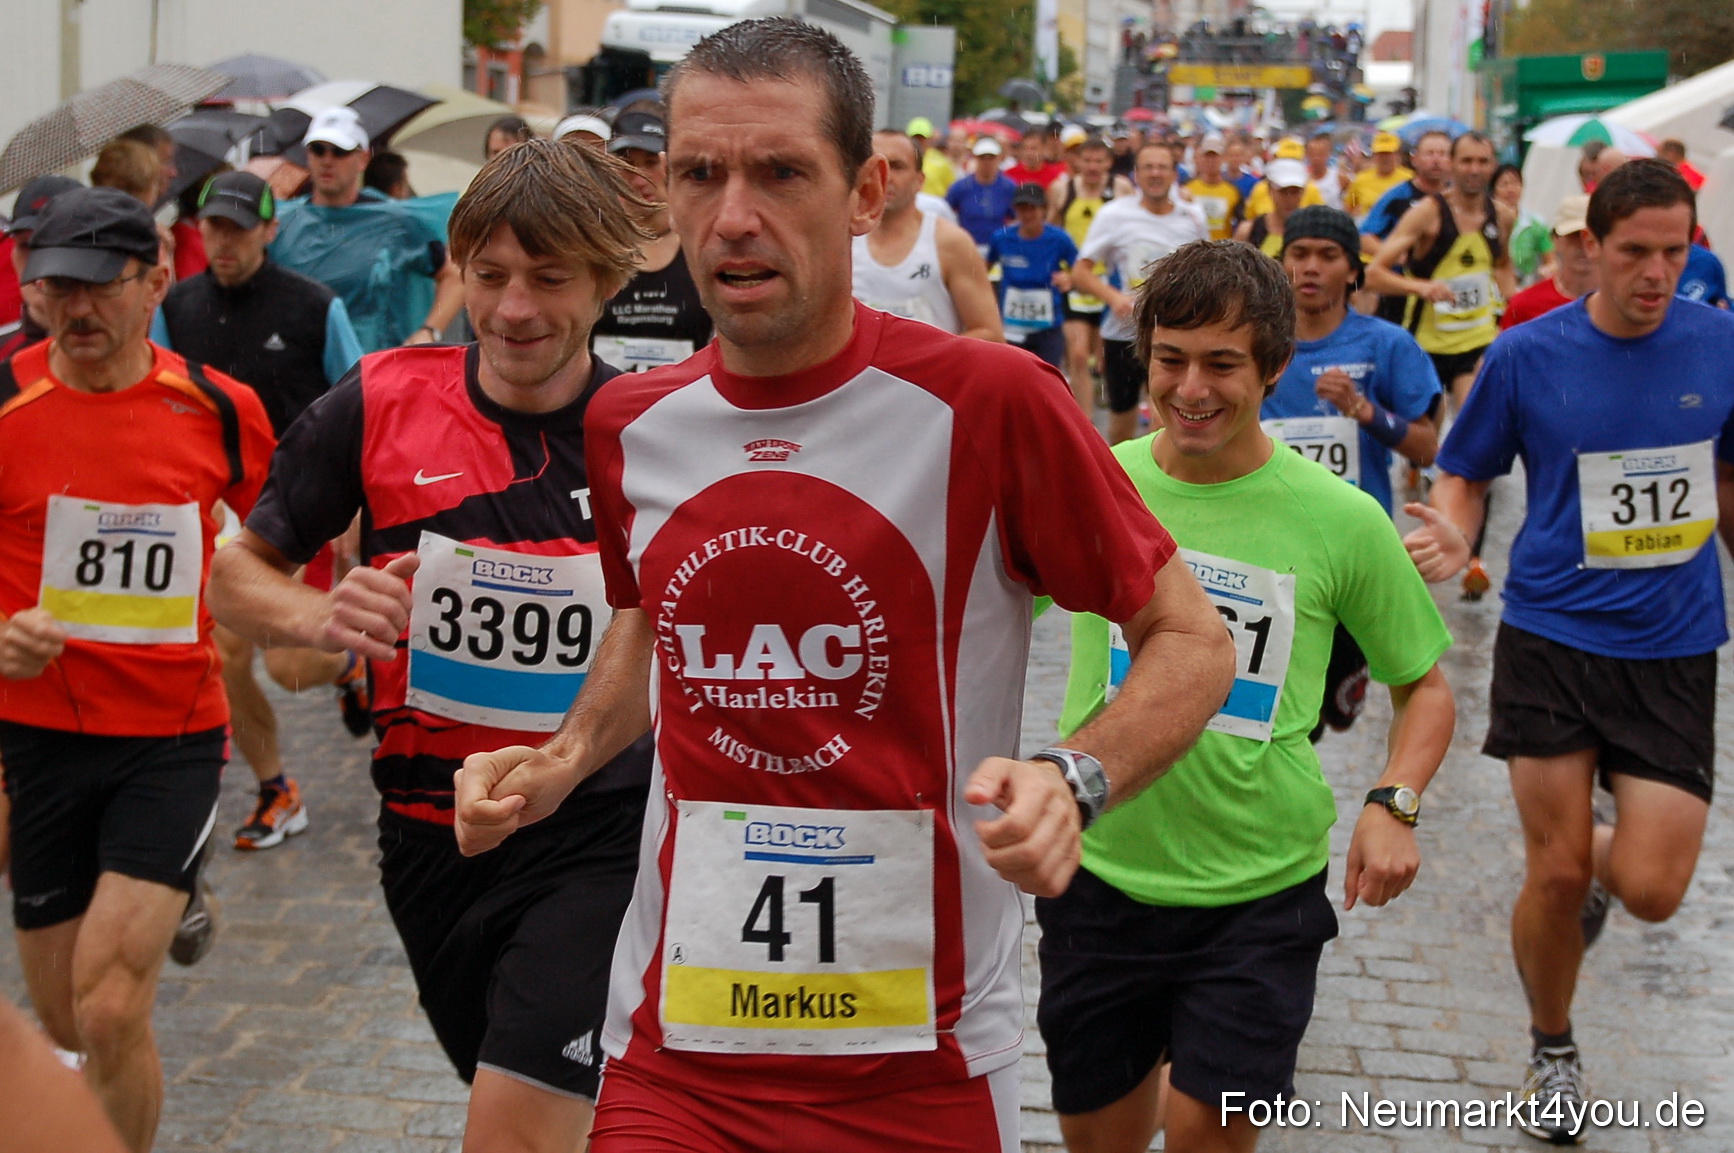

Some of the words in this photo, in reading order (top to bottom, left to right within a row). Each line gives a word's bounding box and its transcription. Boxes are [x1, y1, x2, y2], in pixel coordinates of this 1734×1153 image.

[612, 304, 632, 315] LLC
[634, 304, 678, 315] Marathon
[1611, 478, 1691, 525] 312
[76, 539, 175, 593] 810
[1624, 533, 1683, 552] Fabian
[473, 559, 554, 585] BOCK
[428, 586, 593, 668] 3399
[841, 574, 890, 721] HARLEKIN
[675, 623, 864, 680] LAC
[702, 685, 839, 709] Harlekin
[707, 726, 852, 775] MISTELBACH
[745, 822, 846, 850] BOCK
[741, 875, 836, 963] 41
[731, 983, 857, 1019] Markus
